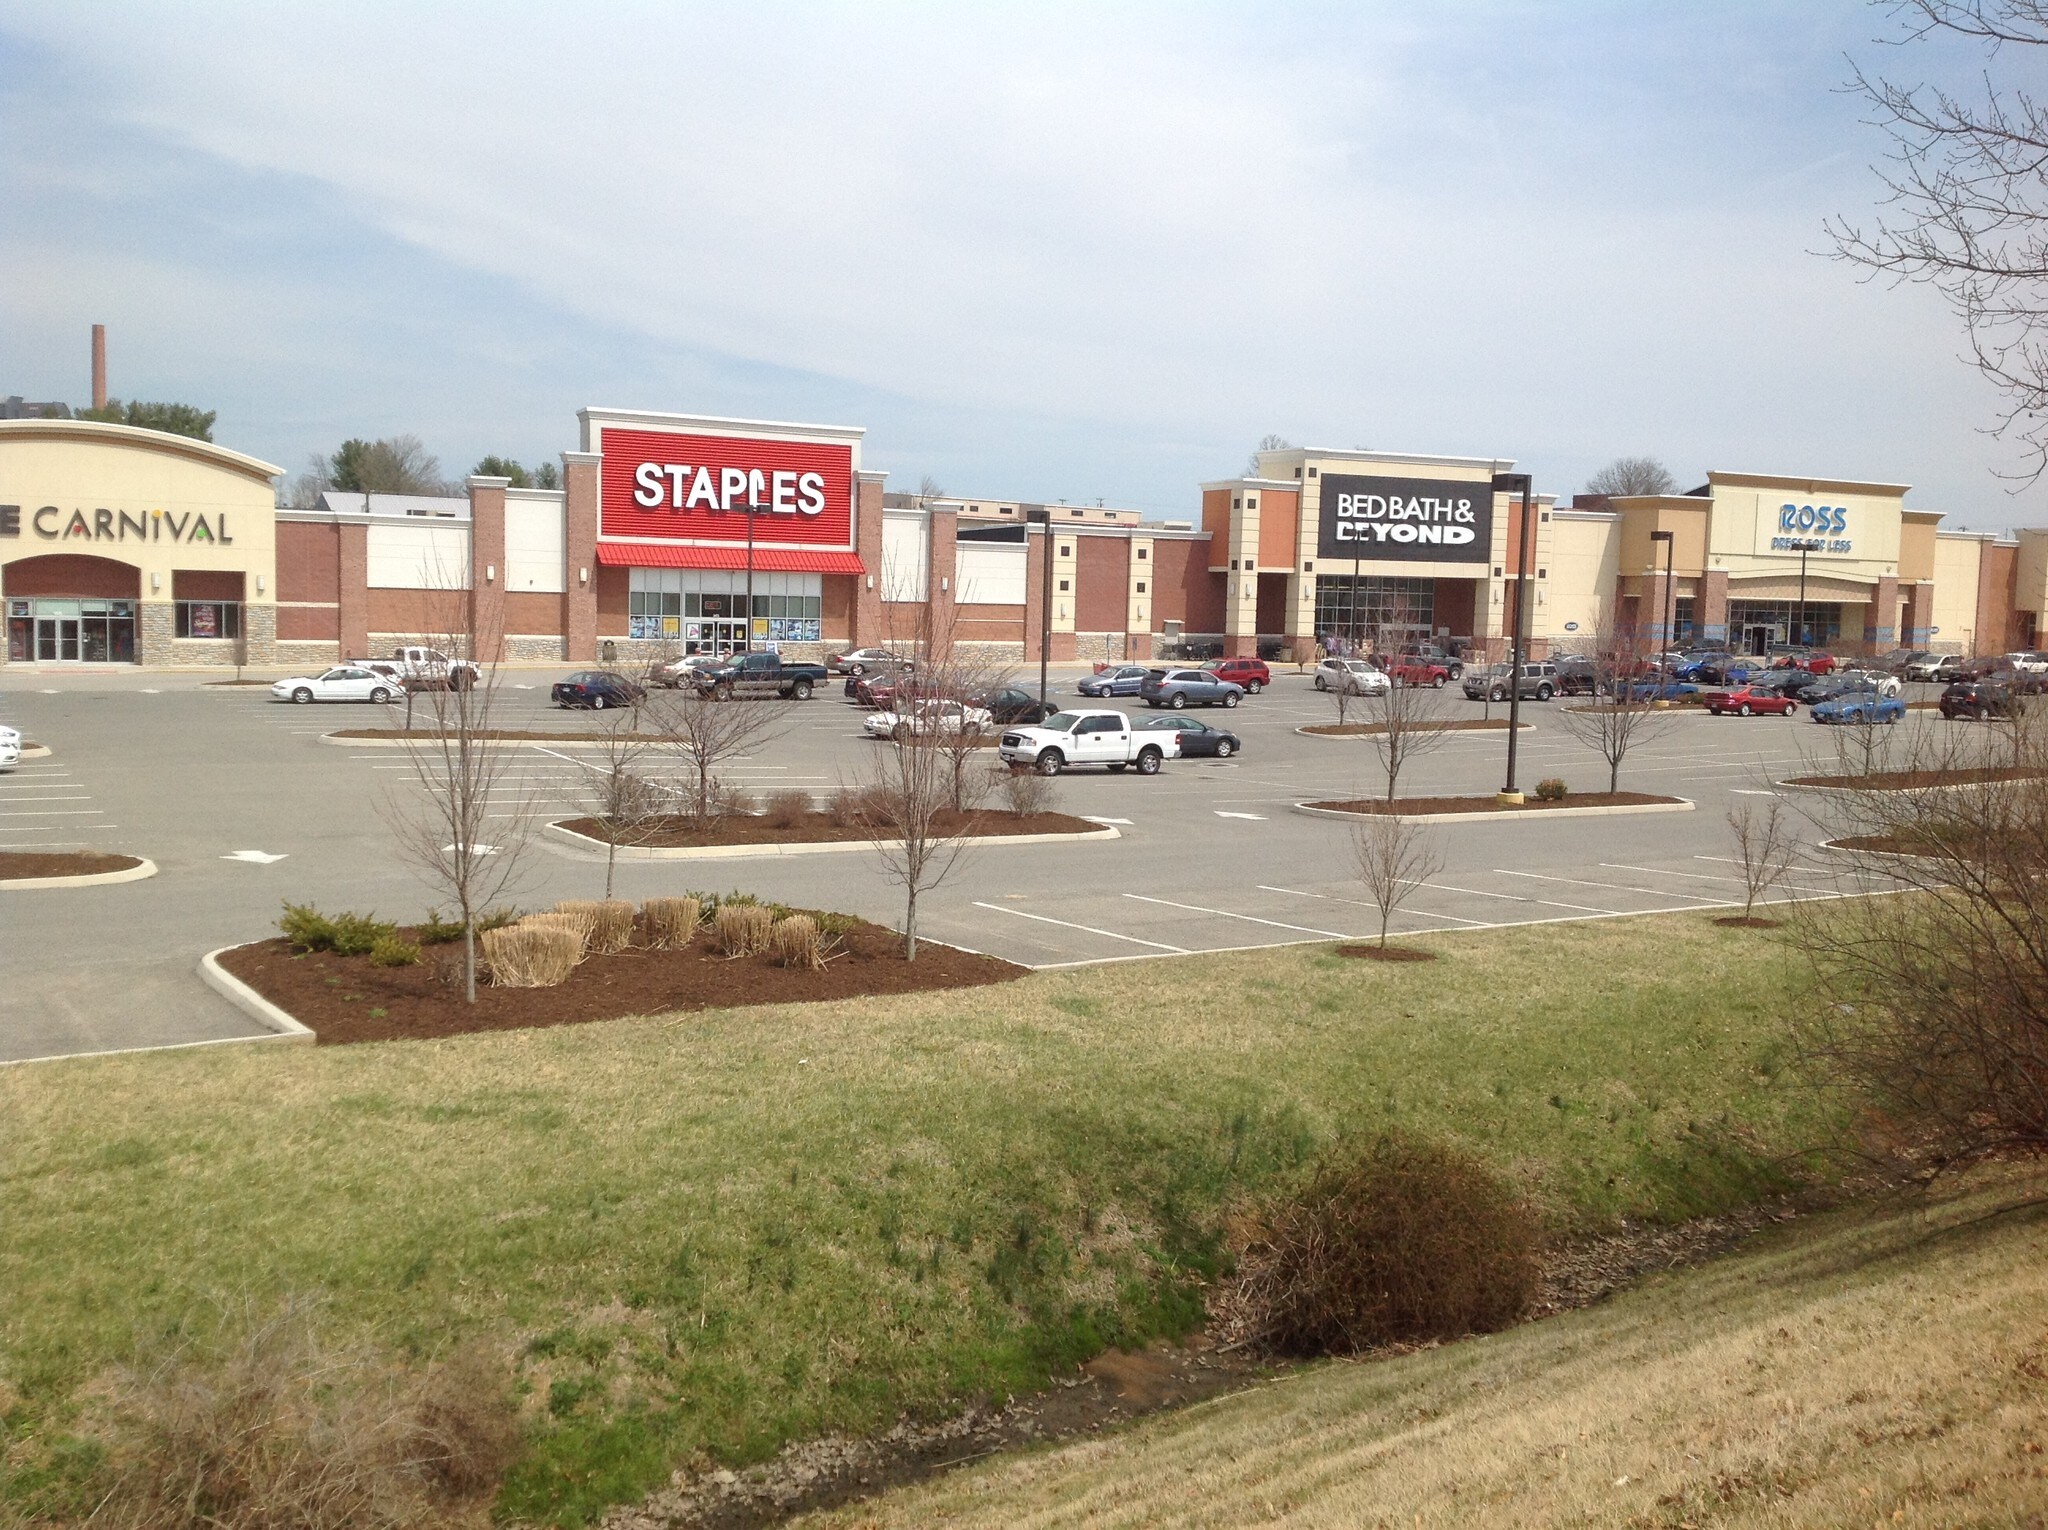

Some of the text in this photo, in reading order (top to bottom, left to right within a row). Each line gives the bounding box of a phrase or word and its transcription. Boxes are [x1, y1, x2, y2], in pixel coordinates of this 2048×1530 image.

[634, 462, 826, 515] STAPLES
[1337, 493, 1476, 523] BED BATH &
[1780, 503, 1848, 533] ROSS
[33, 505, 233, 545] CARNIVAL
[1828, 539, 1852, 553] LESS
